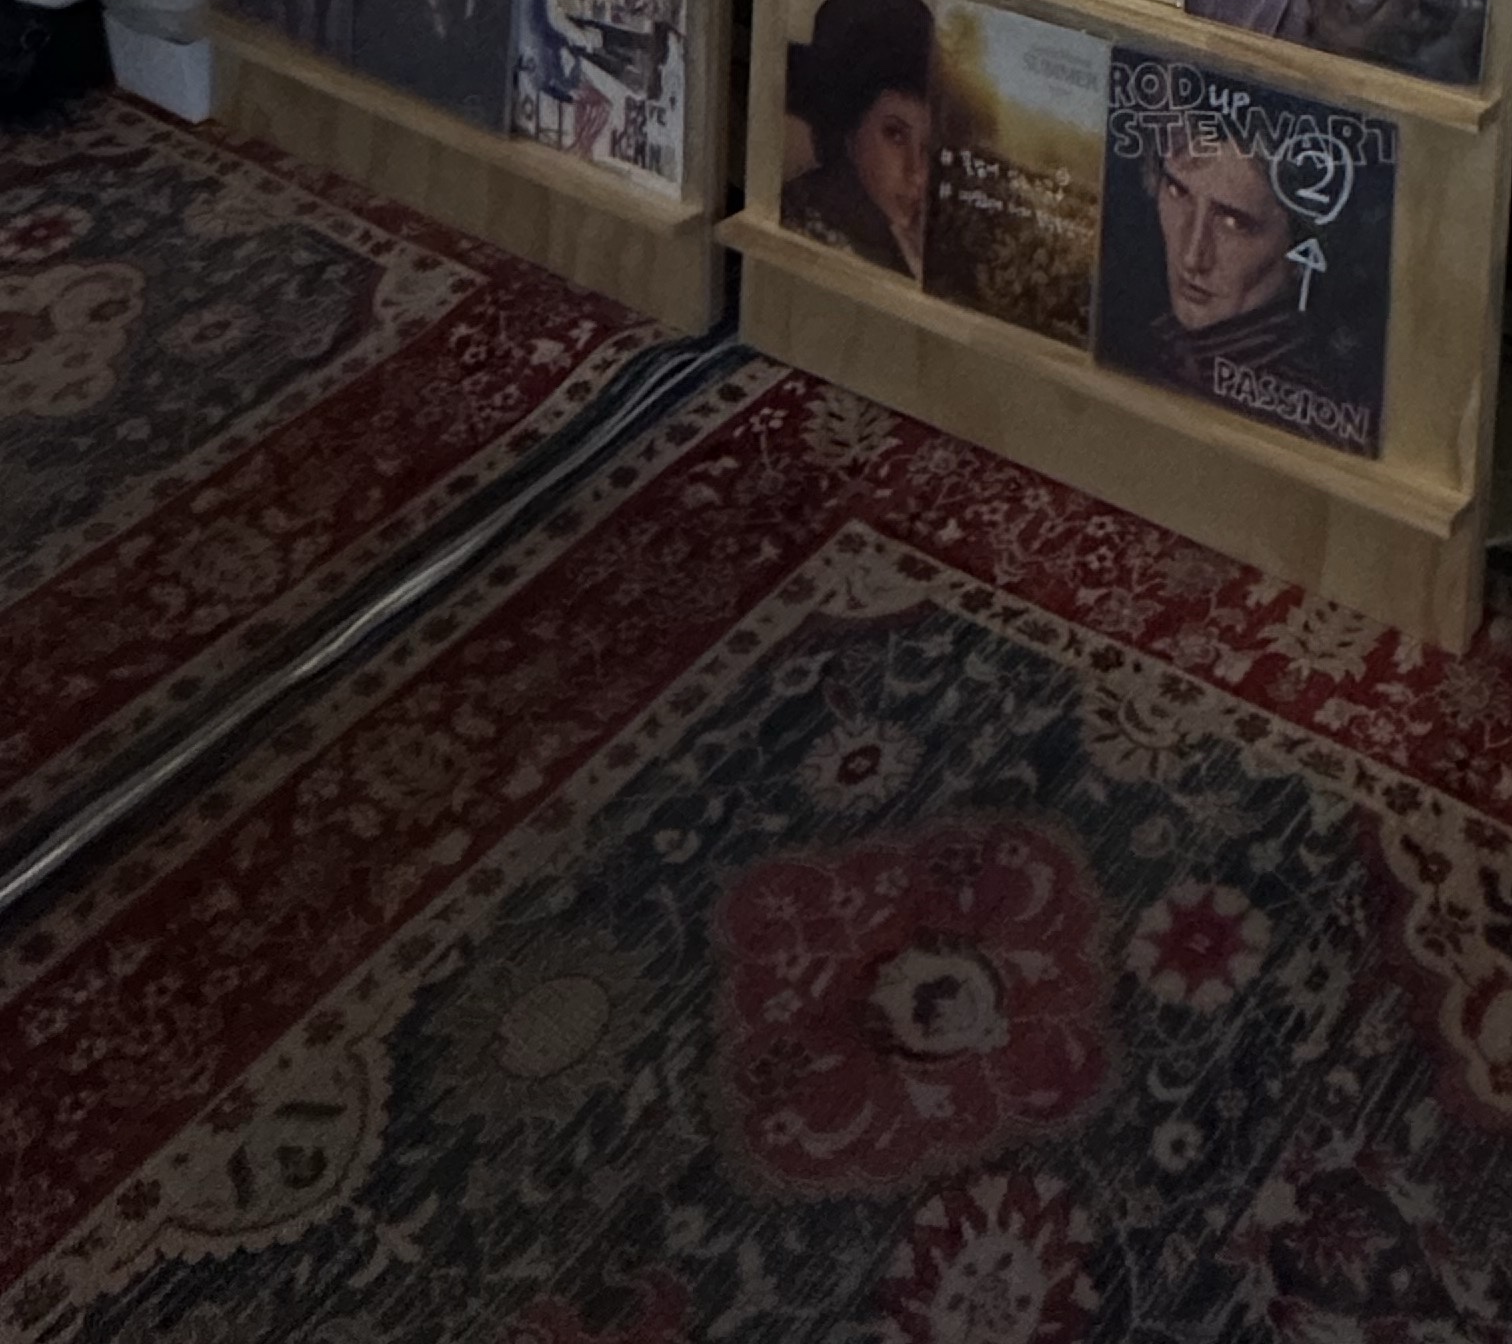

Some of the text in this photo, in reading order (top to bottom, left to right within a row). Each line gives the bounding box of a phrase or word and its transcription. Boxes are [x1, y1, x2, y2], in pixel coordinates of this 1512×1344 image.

[1110, 62, 1204, 112] ROD
[1113, 107, 1398, 168] STEWART
[1214, 357, 1371, 440] PASSION
